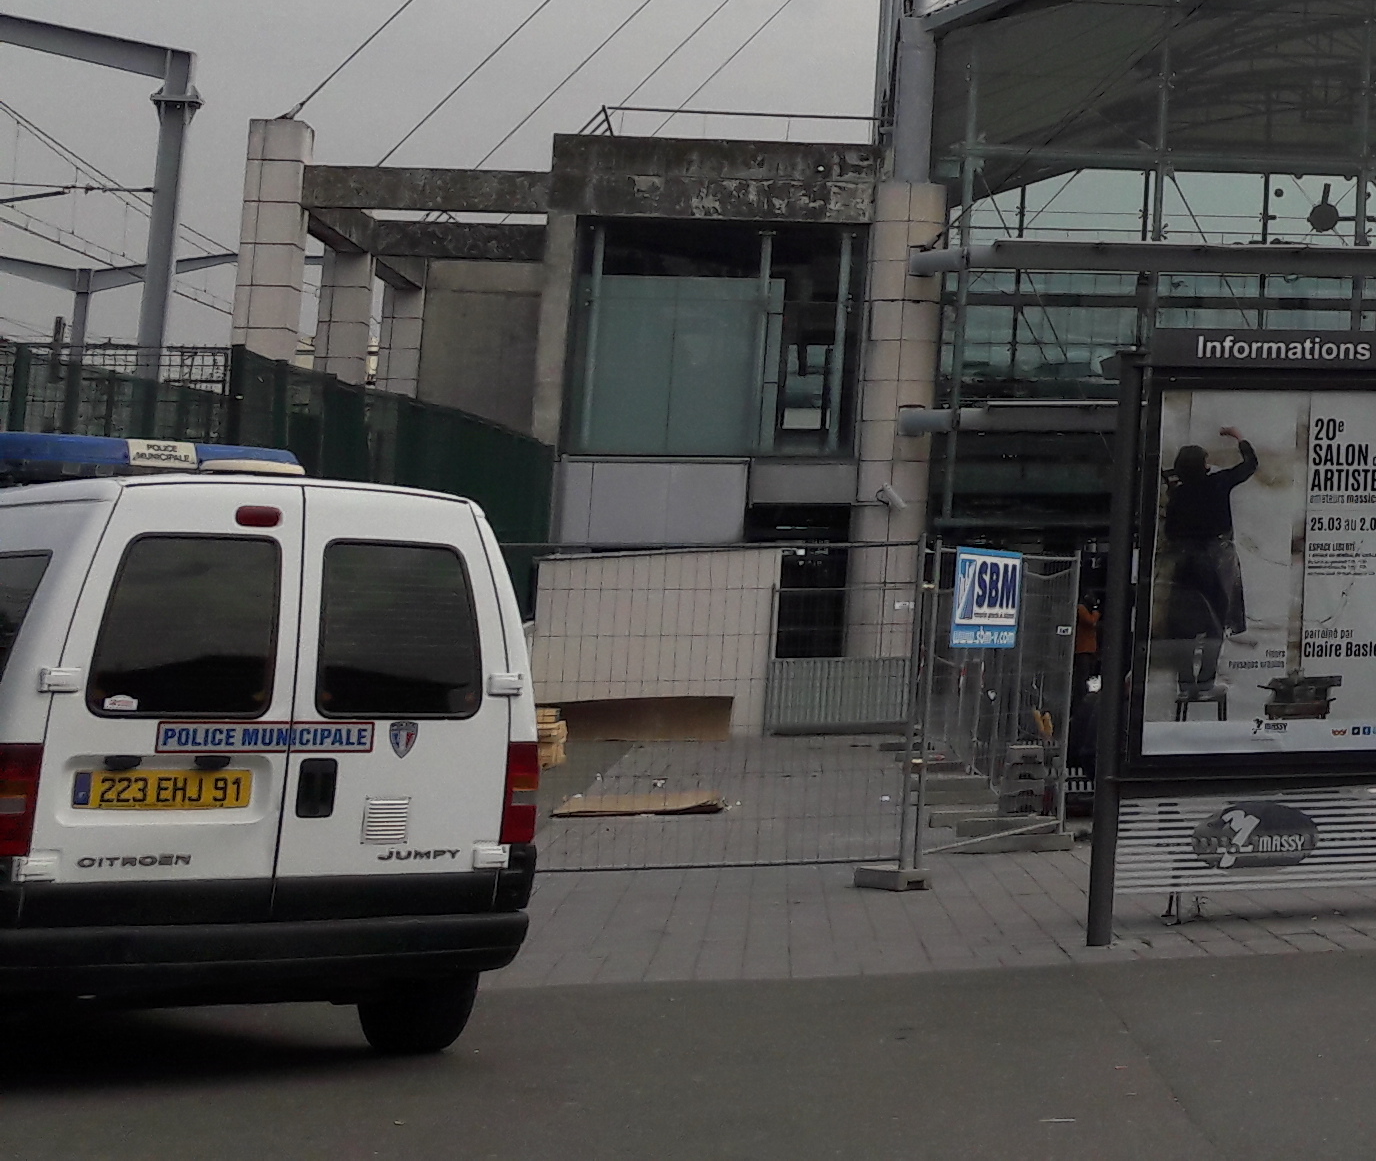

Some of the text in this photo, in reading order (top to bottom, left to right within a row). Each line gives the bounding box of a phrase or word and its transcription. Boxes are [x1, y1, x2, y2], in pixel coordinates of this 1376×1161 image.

[1196, 336, 1372, 361] Informations
[1313, 417, 1345, 441] 20e
[133, 451, 191, 464] MUNICIPALE
[146, 443, 178, 454] POLICE
[1312, 443, 1369, 467] SALON
[1310, 516, 1342, 532] 25.03
[1344, 518, 1357, 531] au
[975, 560, 1018, 609] SBM
[1340, 629, 1354, 639] par
[1303, 641, 1342, 657] Claire
[161, 727, 368, 747] POLICE MUNICIPALE
[99, 777, 243, 803] 223 EHJ 91
[1258, 834, 1305, 852] MASSY
[377, 849, 461, 861] JUMPY
